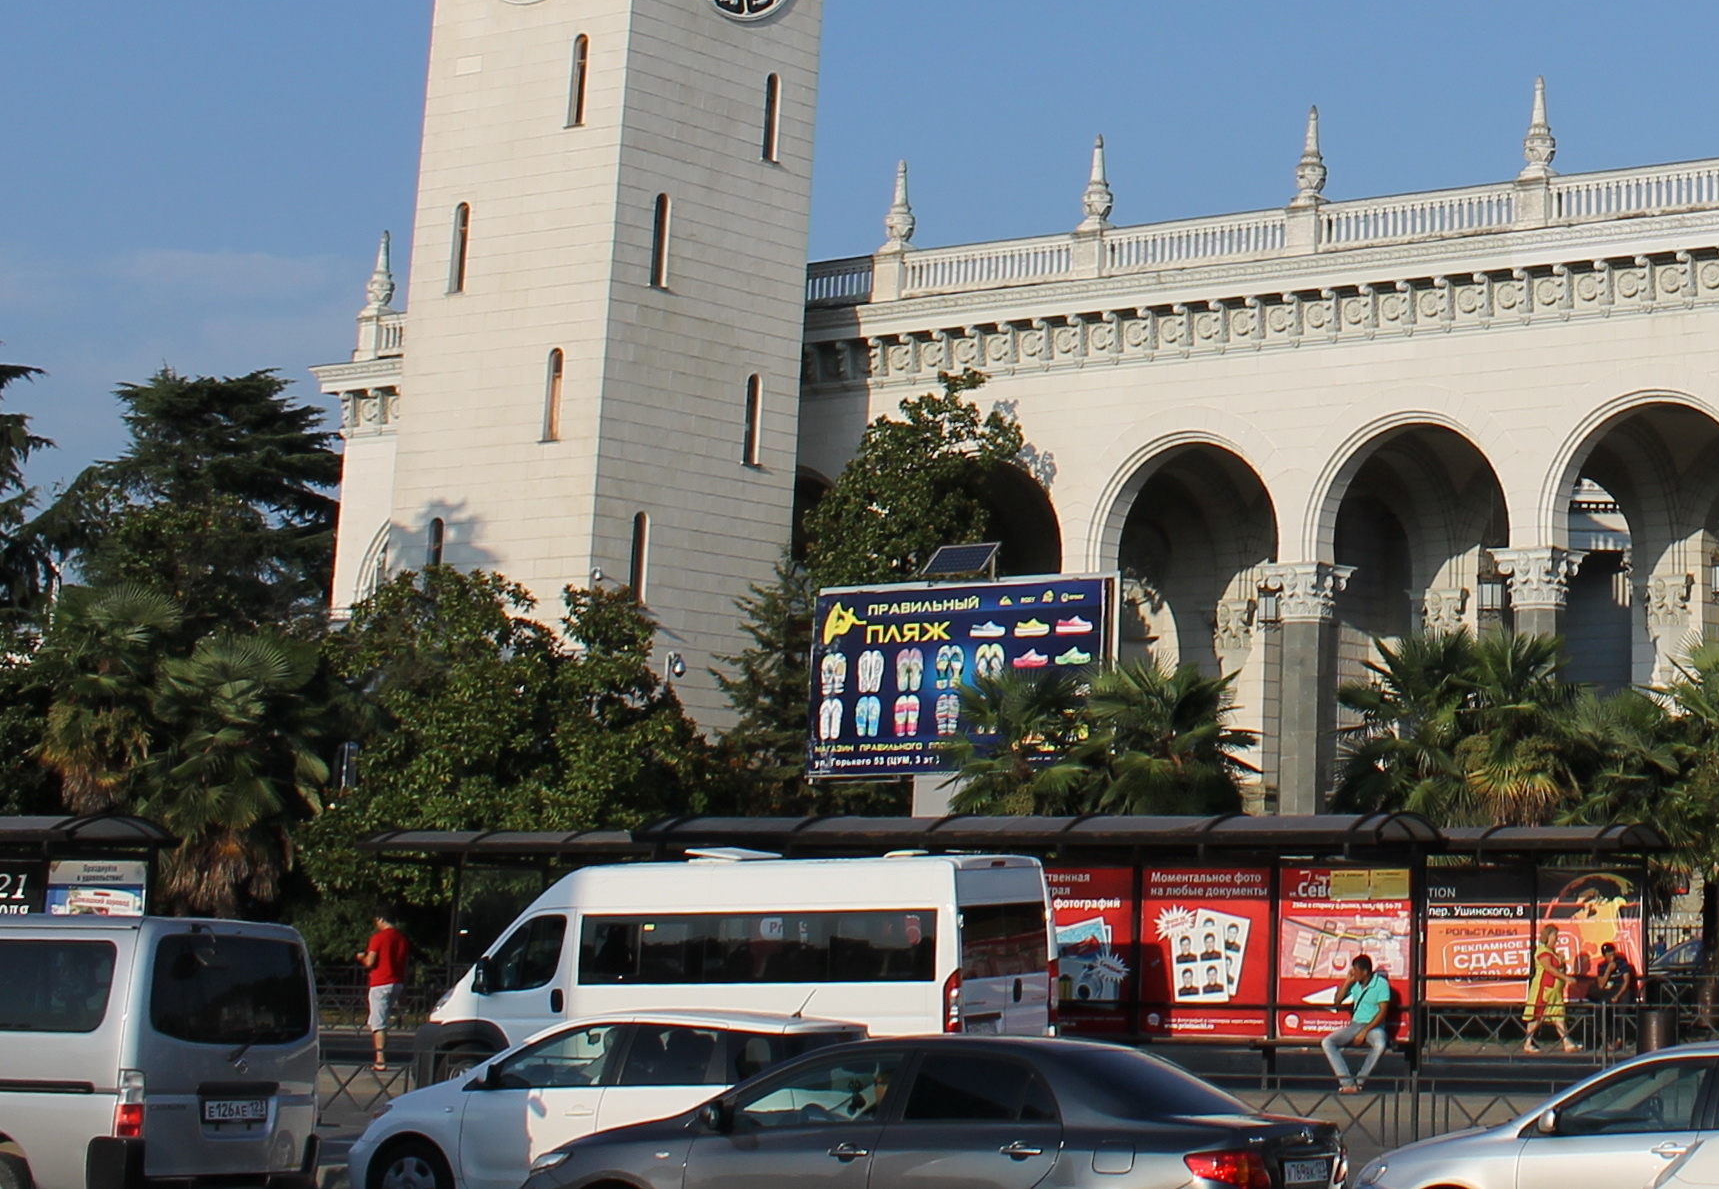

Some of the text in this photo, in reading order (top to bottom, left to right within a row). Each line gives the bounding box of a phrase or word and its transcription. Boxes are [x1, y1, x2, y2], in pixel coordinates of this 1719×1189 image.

[868, 596, 979, 616] ПРАВИЛЬНЫЙ
[866, 621, 951, 644] ПЛЯЖ
[815, 744, 854, 753] МАГАЗИН
[859, 742, 922, 752] ПРАВИЛЬНОГО
[831, 757, 871, 768] Горького
[1151, 872, 1261, 885] Моментальное фото
[1166, 885, 1203, 896] любые
[1205, 888, 1267, 898] документы
[1053, 897, 1121, 911] фотографий
[1454, 906, 1513, 918] Ушинского,
[1517, 906, 1524, 915] 8
[1454, 941, 1524, 953] РЕКЛАМНОЕ
